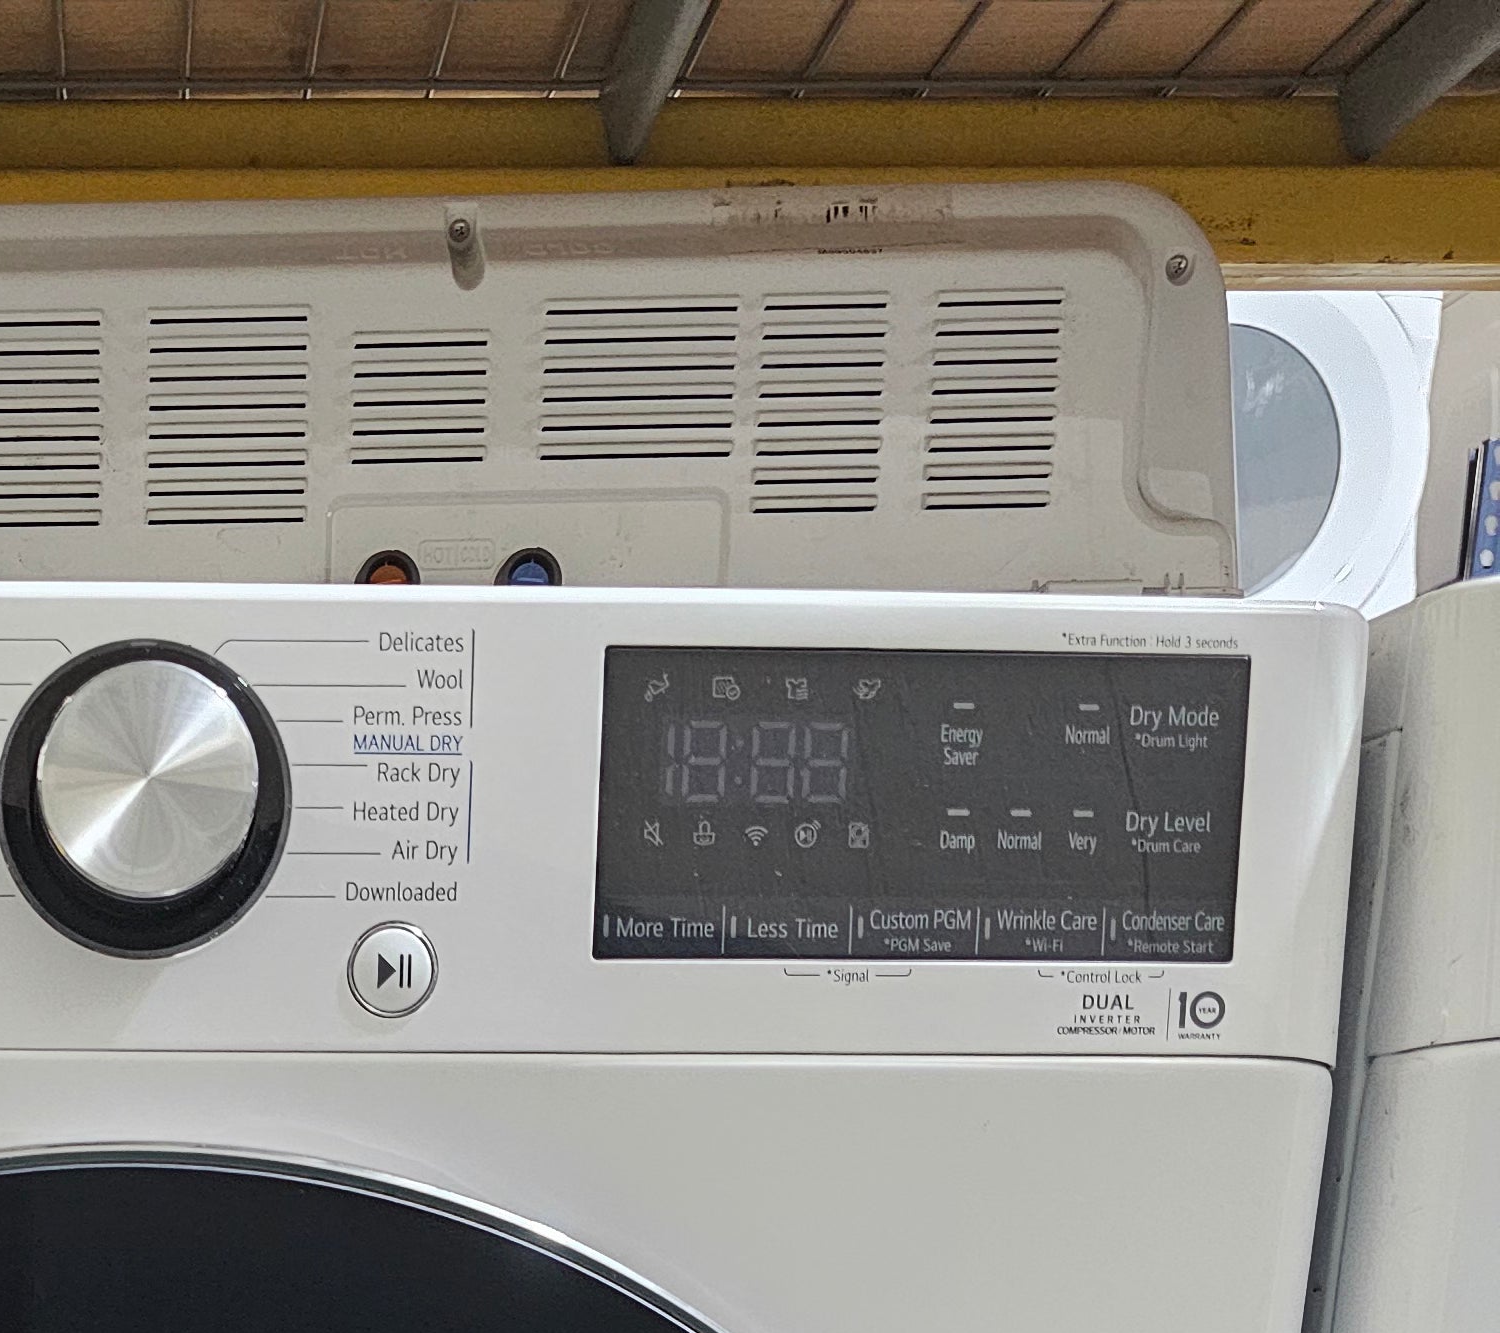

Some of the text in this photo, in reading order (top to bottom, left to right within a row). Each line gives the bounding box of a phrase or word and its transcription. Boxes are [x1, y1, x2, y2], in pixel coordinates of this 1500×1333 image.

[379, 631, 464, 652] Delicates
[1100, 634, 1146, 647] Function
[1156, 635, 1181, 648] Hold
[1185, 636, 1192, 648] 3
[1196, 636, 1238, 649] seconds
[417, 669, 462, 689] Wool
[353, 705, 462, 726] Perm. Press
[1130, 705, 1220, 731] Dry Mode
[353, 734, 463, 752] MANUAL DRY
[940, 724, 983, 748] Energy
[1065, 725, 1110, 745] Normal
[1179, 733, 1208, 751] Light
[943, 748, 979, 766] Saver
[377, 762, 460, 788] Rack Dry
[353, 801, 459, 827] Heated Dry
[1126, 810, 1211, 836] Dry Level
[940, 830, 975, 854] Damp
[997, 829, 1042, 850] Normal
[1068, 830, 1097, 855] Very
[1173, 838, 1201, 853] Care
[391, 840, 458, 866] Air Dry
[346, 881, 457, 901] Downloaded
[616, 916, 714, 938] More Time
[747, 917, 838, 939] Less Time
[870, 909, 971, 930] Custom PGM
[997, 909, 1097, 931] Wrinkle Care
[1122, 909, 1225, 932] Condenser Care
[923, 938, 951, 952] Save
[1183, 939, 1214, 954] Start
[1115, 970, 1142, 984] Lock
[1082, 994, 1134, 1010] DUAL
[1178, 990, 1226, 1029] 10
[1074, 1015, 1141, 1024] INVERTER
